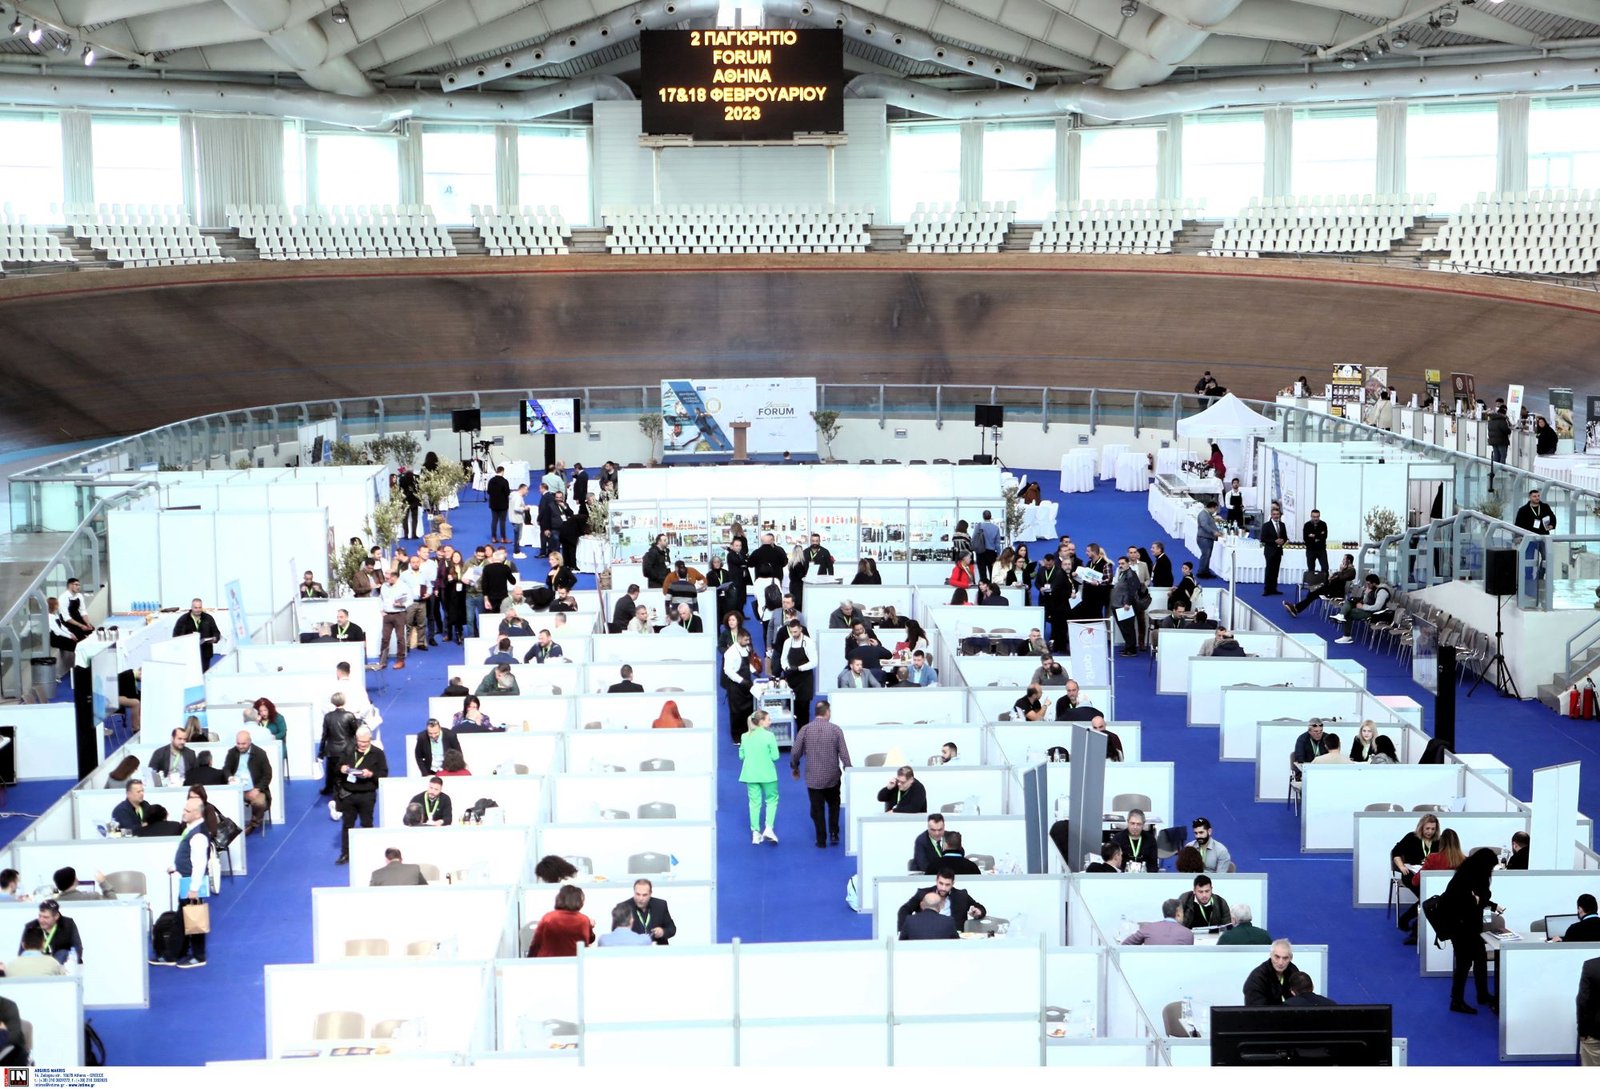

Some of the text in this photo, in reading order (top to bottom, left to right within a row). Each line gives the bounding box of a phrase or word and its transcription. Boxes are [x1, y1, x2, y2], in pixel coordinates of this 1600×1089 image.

[691, 31, 797, 46] 2 ΠΑΓΚΡΗΤΙΟ
[713, 50, 771, 64] FORUM
[713, 69, 771, 83] ΑΘΗΝΑ
[659, 88, 826, 102] 17&18 ΦΕΒΡΟΥΑΡΙΟΥ
[725, 106, 761, 120] 2023
[758, 407, 794, 416] FORUM
